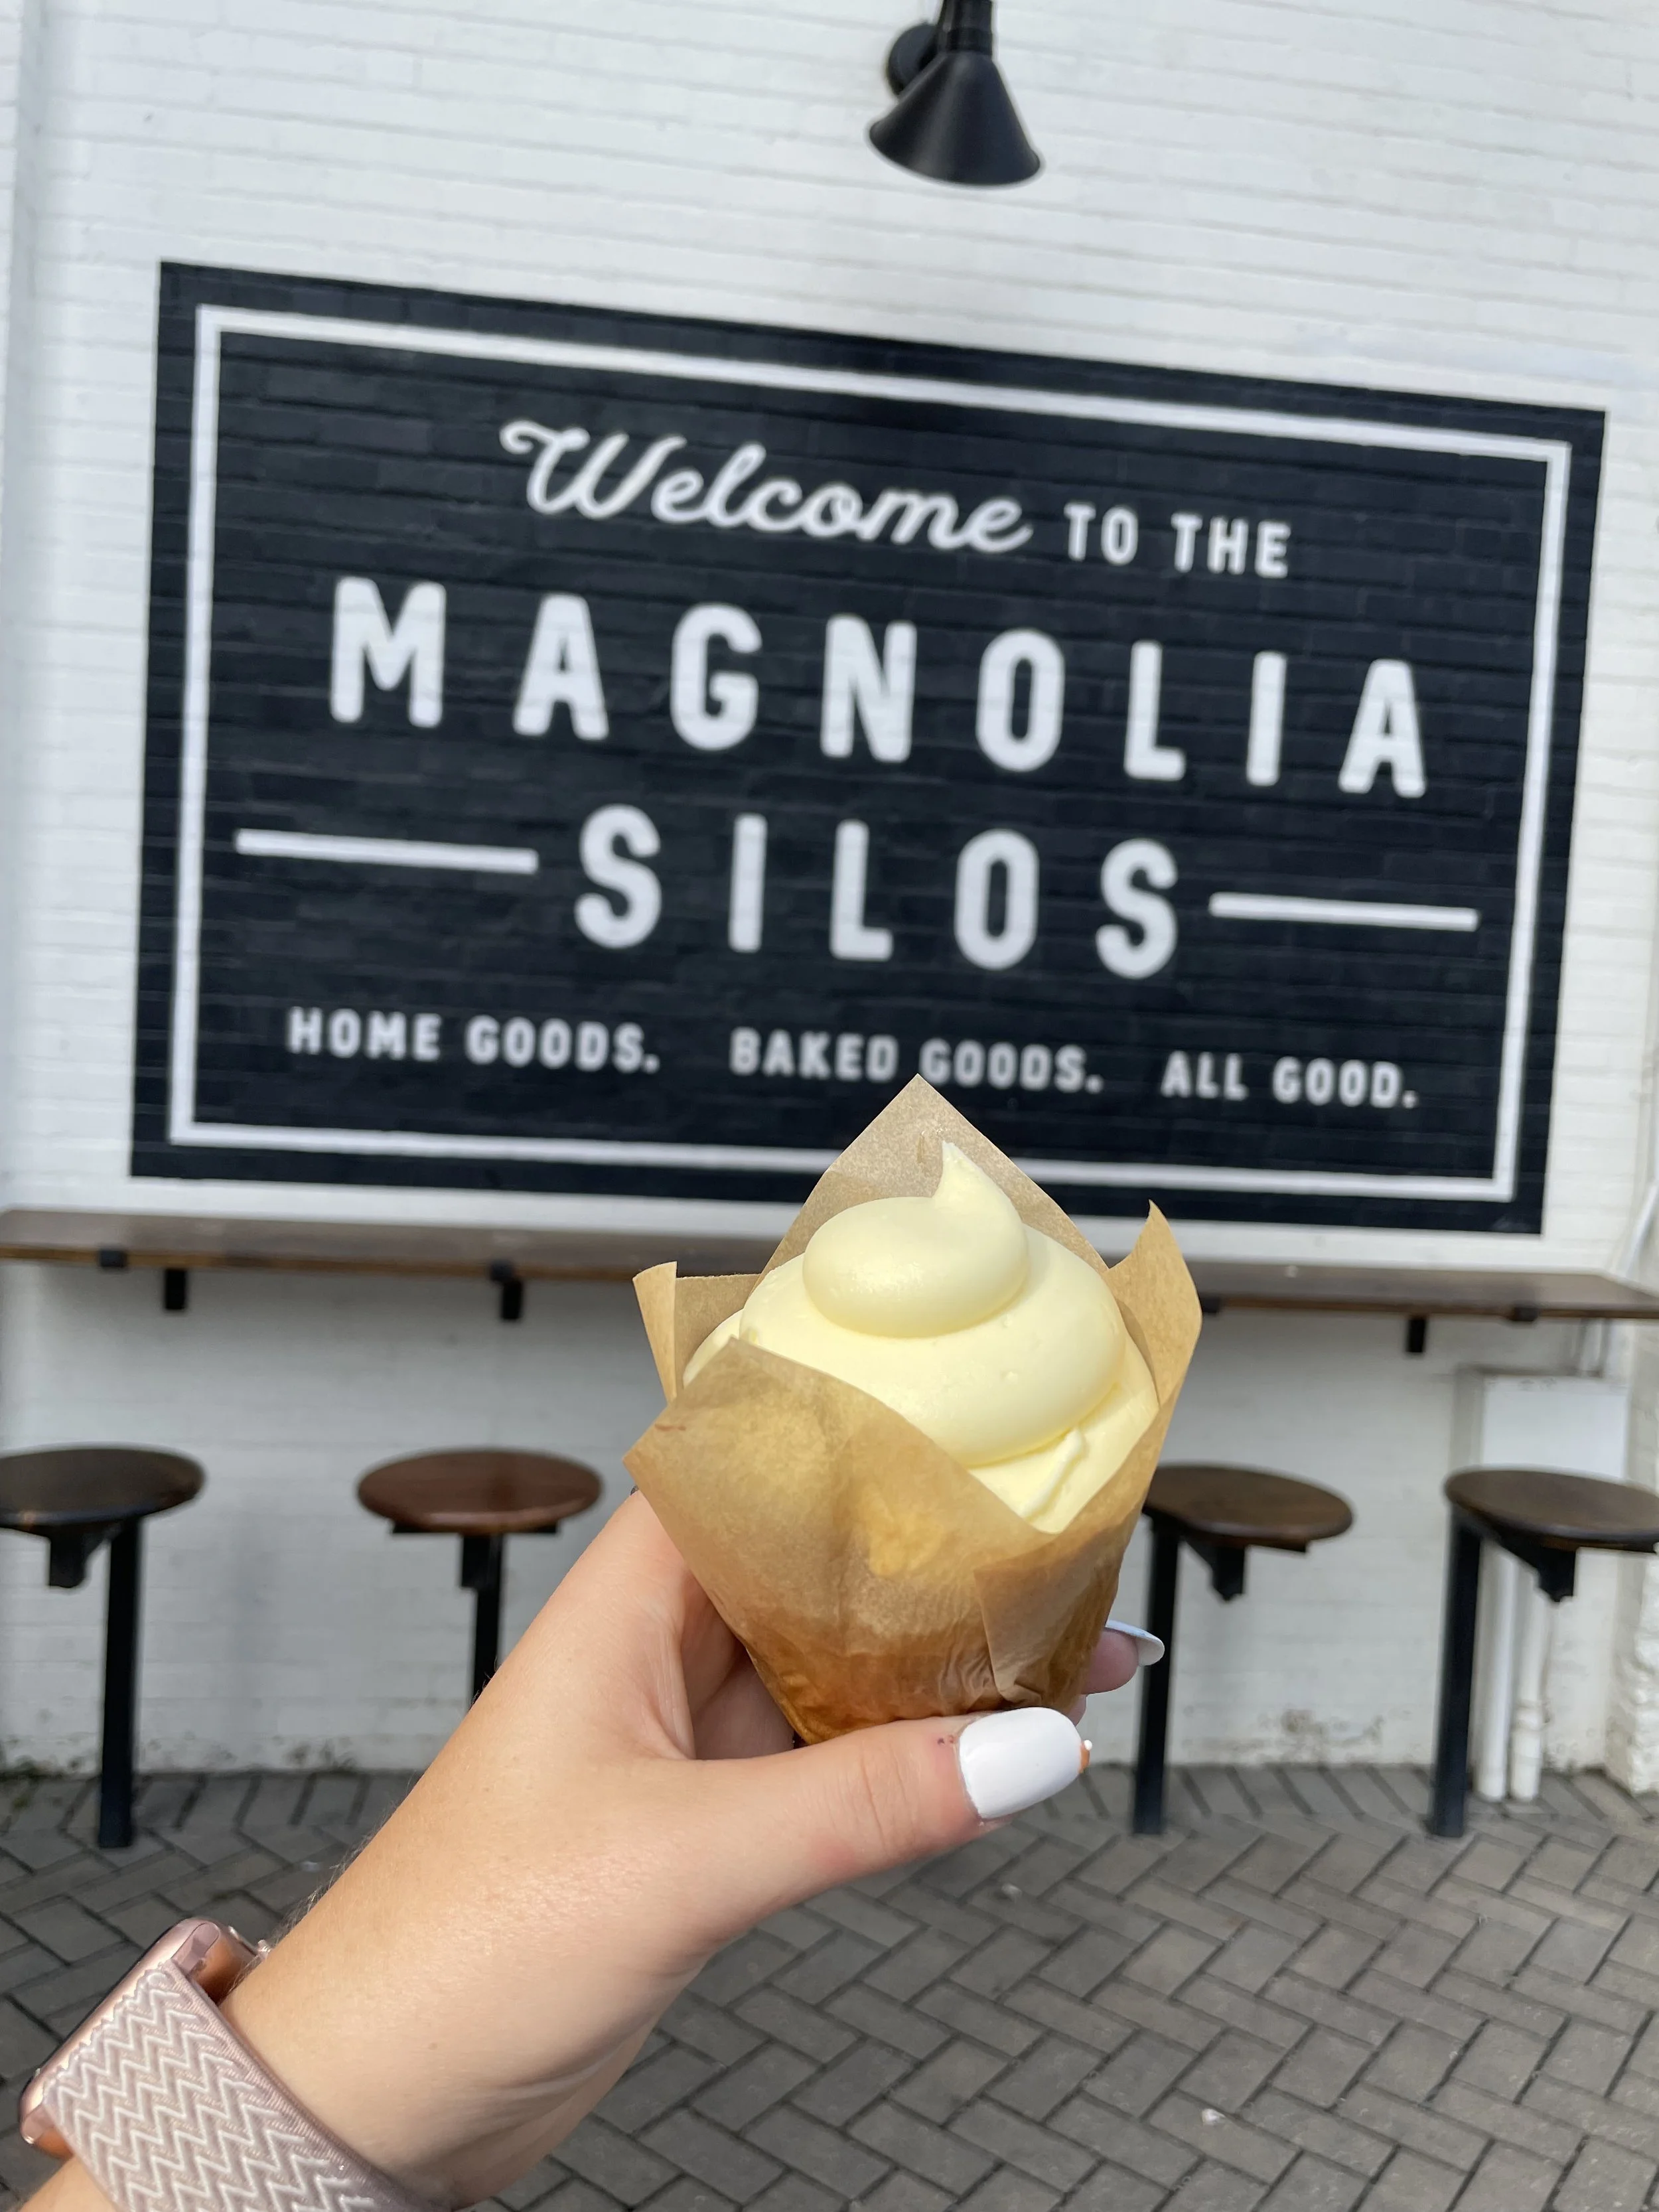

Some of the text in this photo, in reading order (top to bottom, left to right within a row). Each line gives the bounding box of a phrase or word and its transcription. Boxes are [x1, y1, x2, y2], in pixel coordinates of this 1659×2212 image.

[499, 419, 1292, 579] Welcome TO THE
[329, 575, 1427, 798] MAGNOLIA
[575, 805, 1177, 979] SILOS
[287, 1007, 660, 1073] HOME GOODS.
[731, 1028, 1103, 1093] BAKED GOODS.
[1161, 1052, 1418, 1108] ALL GOOD.
